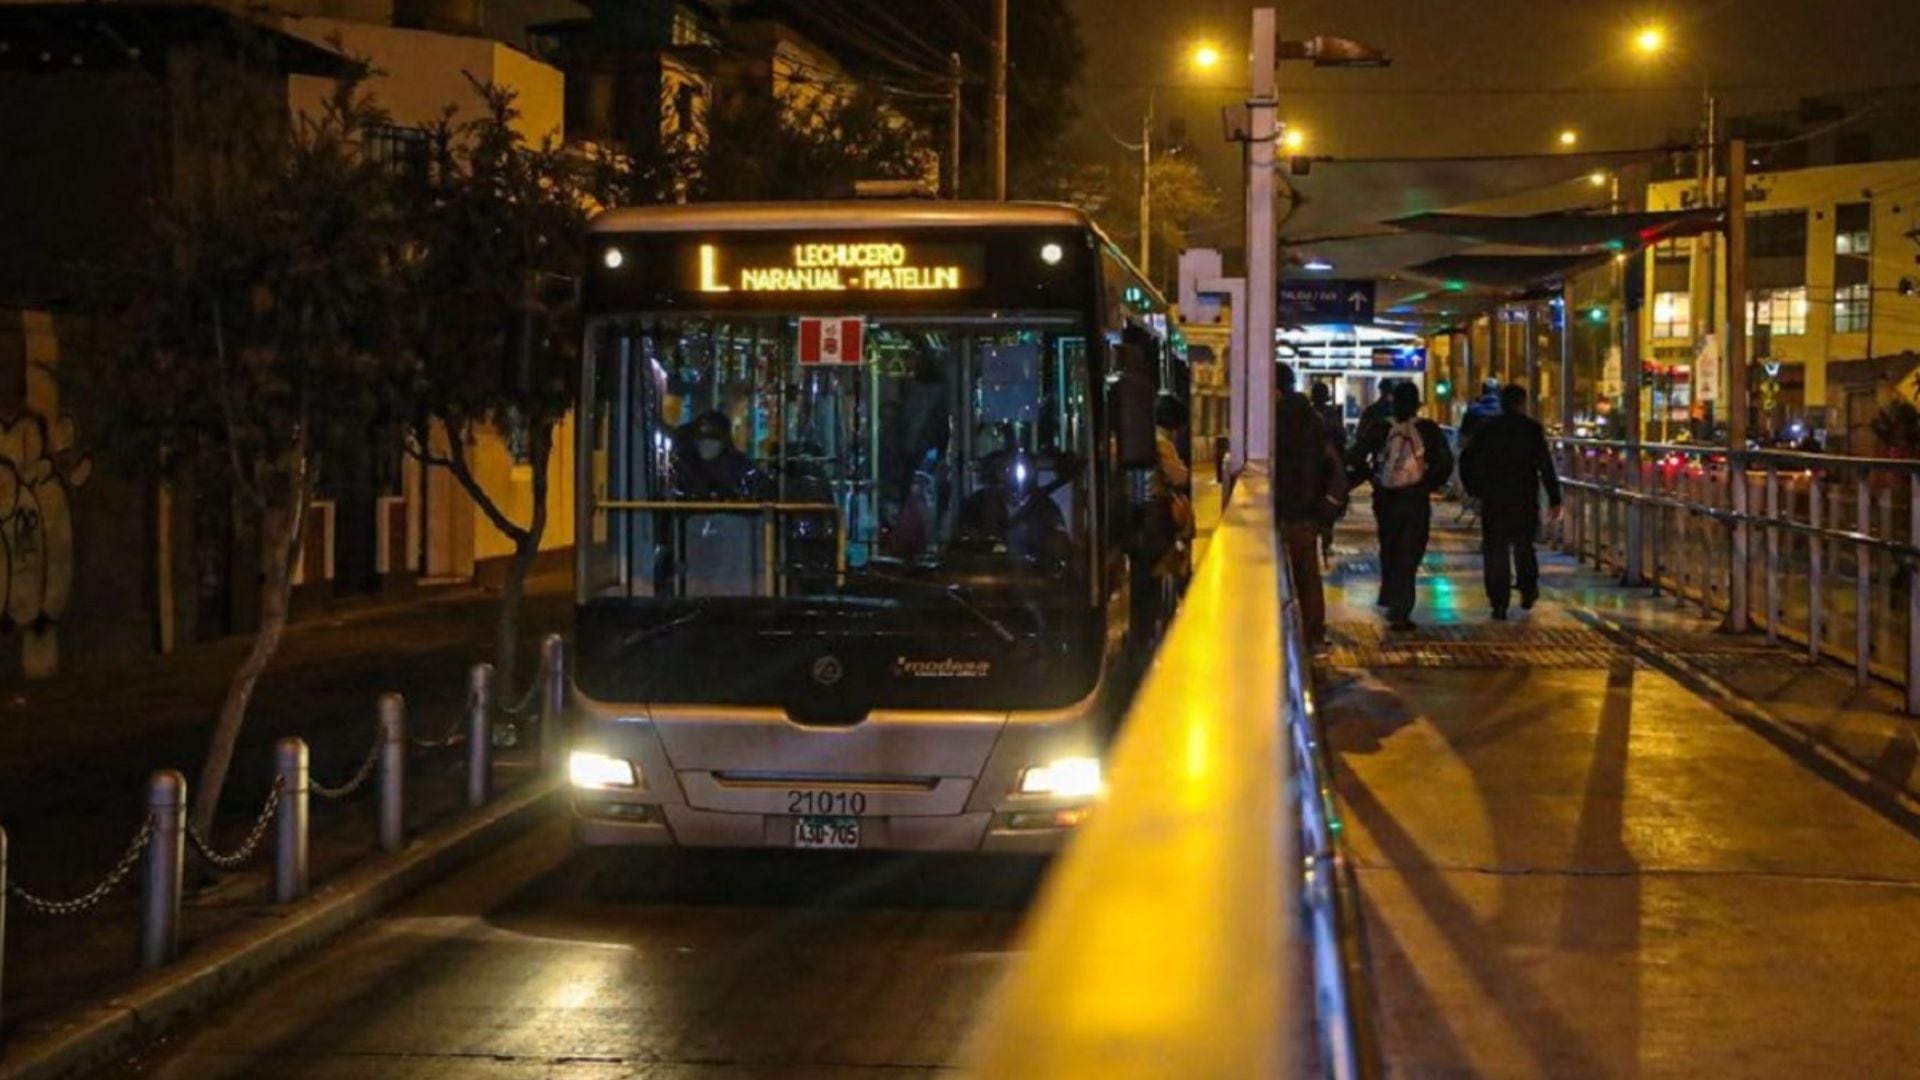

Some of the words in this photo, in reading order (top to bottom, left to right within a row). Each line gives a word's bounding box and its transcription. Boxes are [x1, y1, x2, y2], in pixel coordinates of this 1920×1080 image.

[796, 244, 905, 266] LECHUCERO
[701, 245, 730, 291] L
[742, 269, 846, 290] NARANJAL
[865, 268, 958, 290] MATELLINI
[788, 791, 866, 814] 21010
